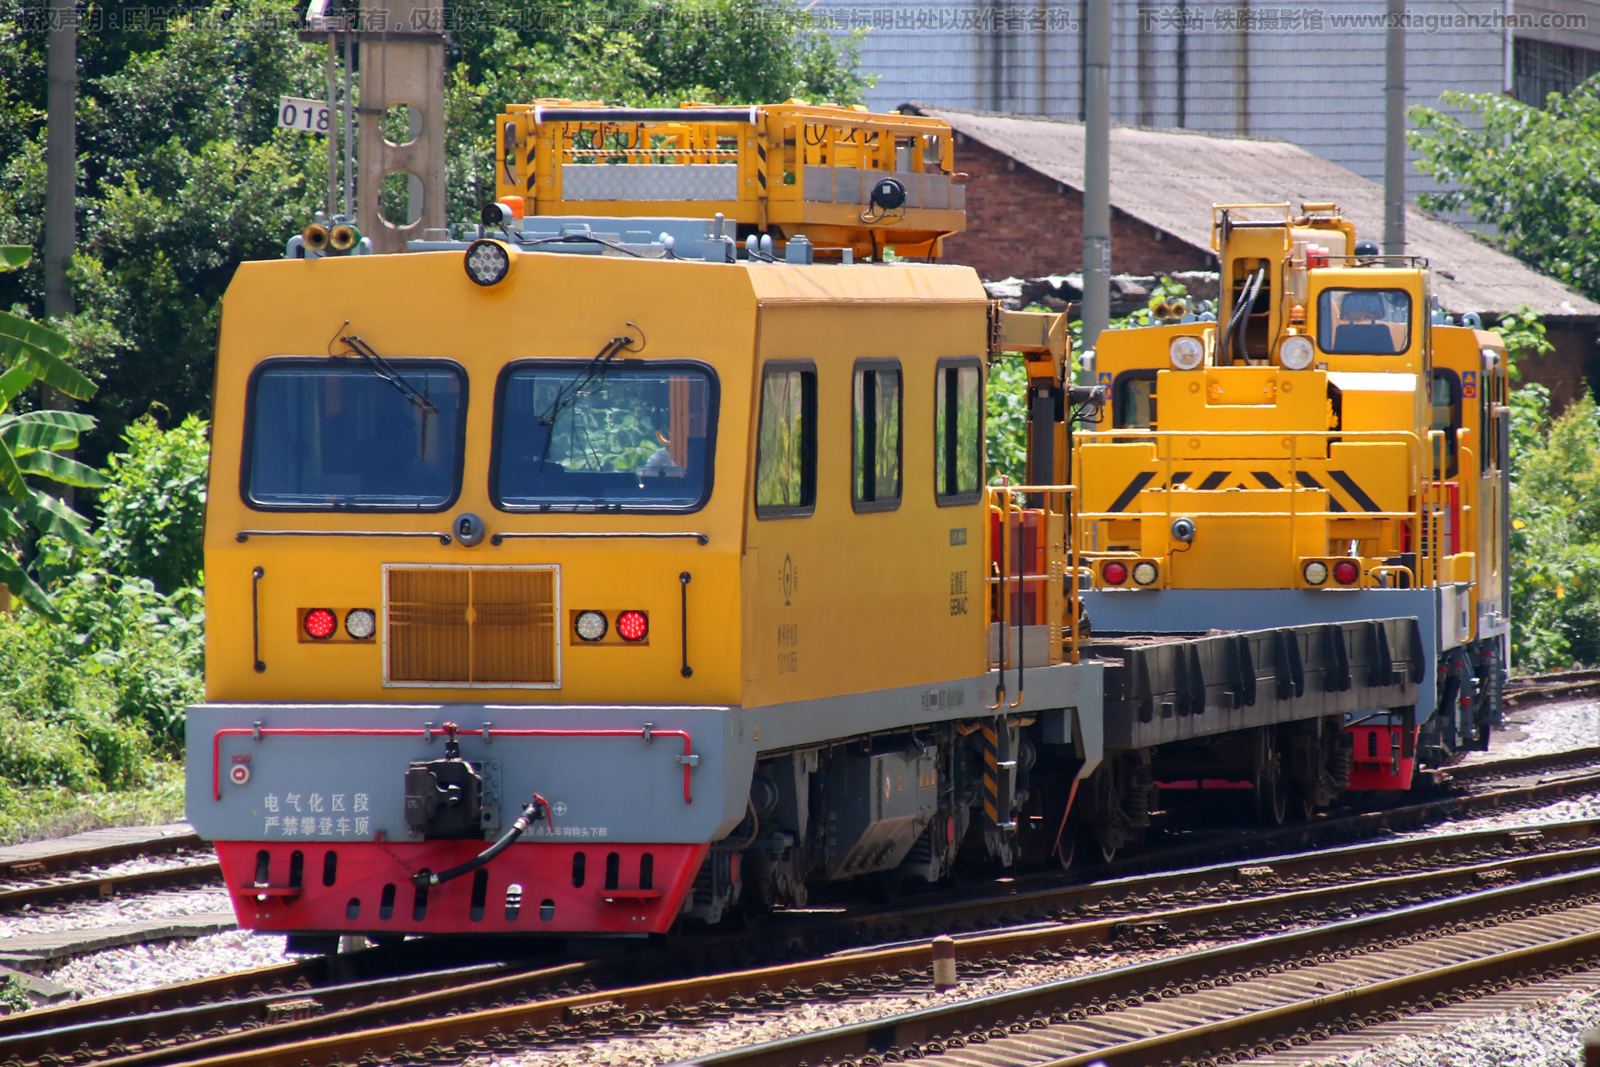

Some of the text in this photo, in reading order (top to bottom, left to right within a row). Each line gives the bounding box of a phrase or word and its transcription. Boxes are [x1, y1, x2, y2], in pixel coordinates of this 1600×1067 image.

[282, 104, 330, 131] 018
[264, 793, 370, 813] 电气化区段
[264, 816, 370, 836] 严禁攀登车顶
